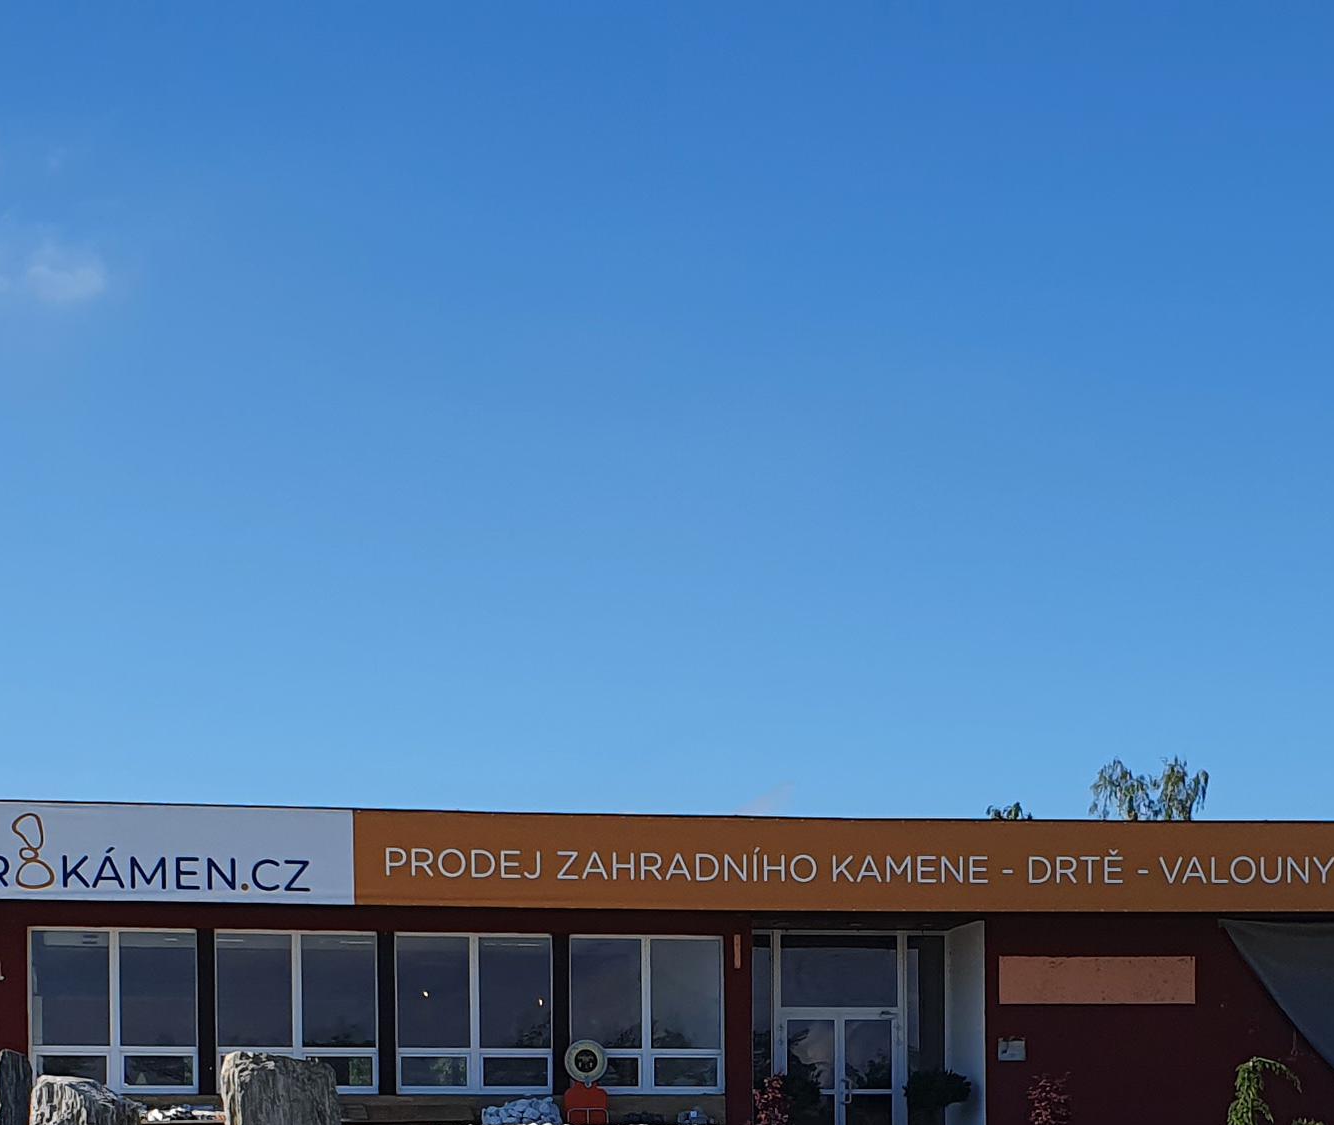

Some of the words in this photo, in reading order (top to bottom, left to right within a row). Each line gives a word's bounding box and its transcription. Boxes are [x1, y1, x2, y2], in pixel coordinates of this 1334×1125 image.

[383, 846, 542, 880] PRODEJ
[557, 847, 818, 883] ZAHRADNÍHO
[831, 854, 989, 884] KAMENE
[1026, 849, 1124, 884] DRTĚ
